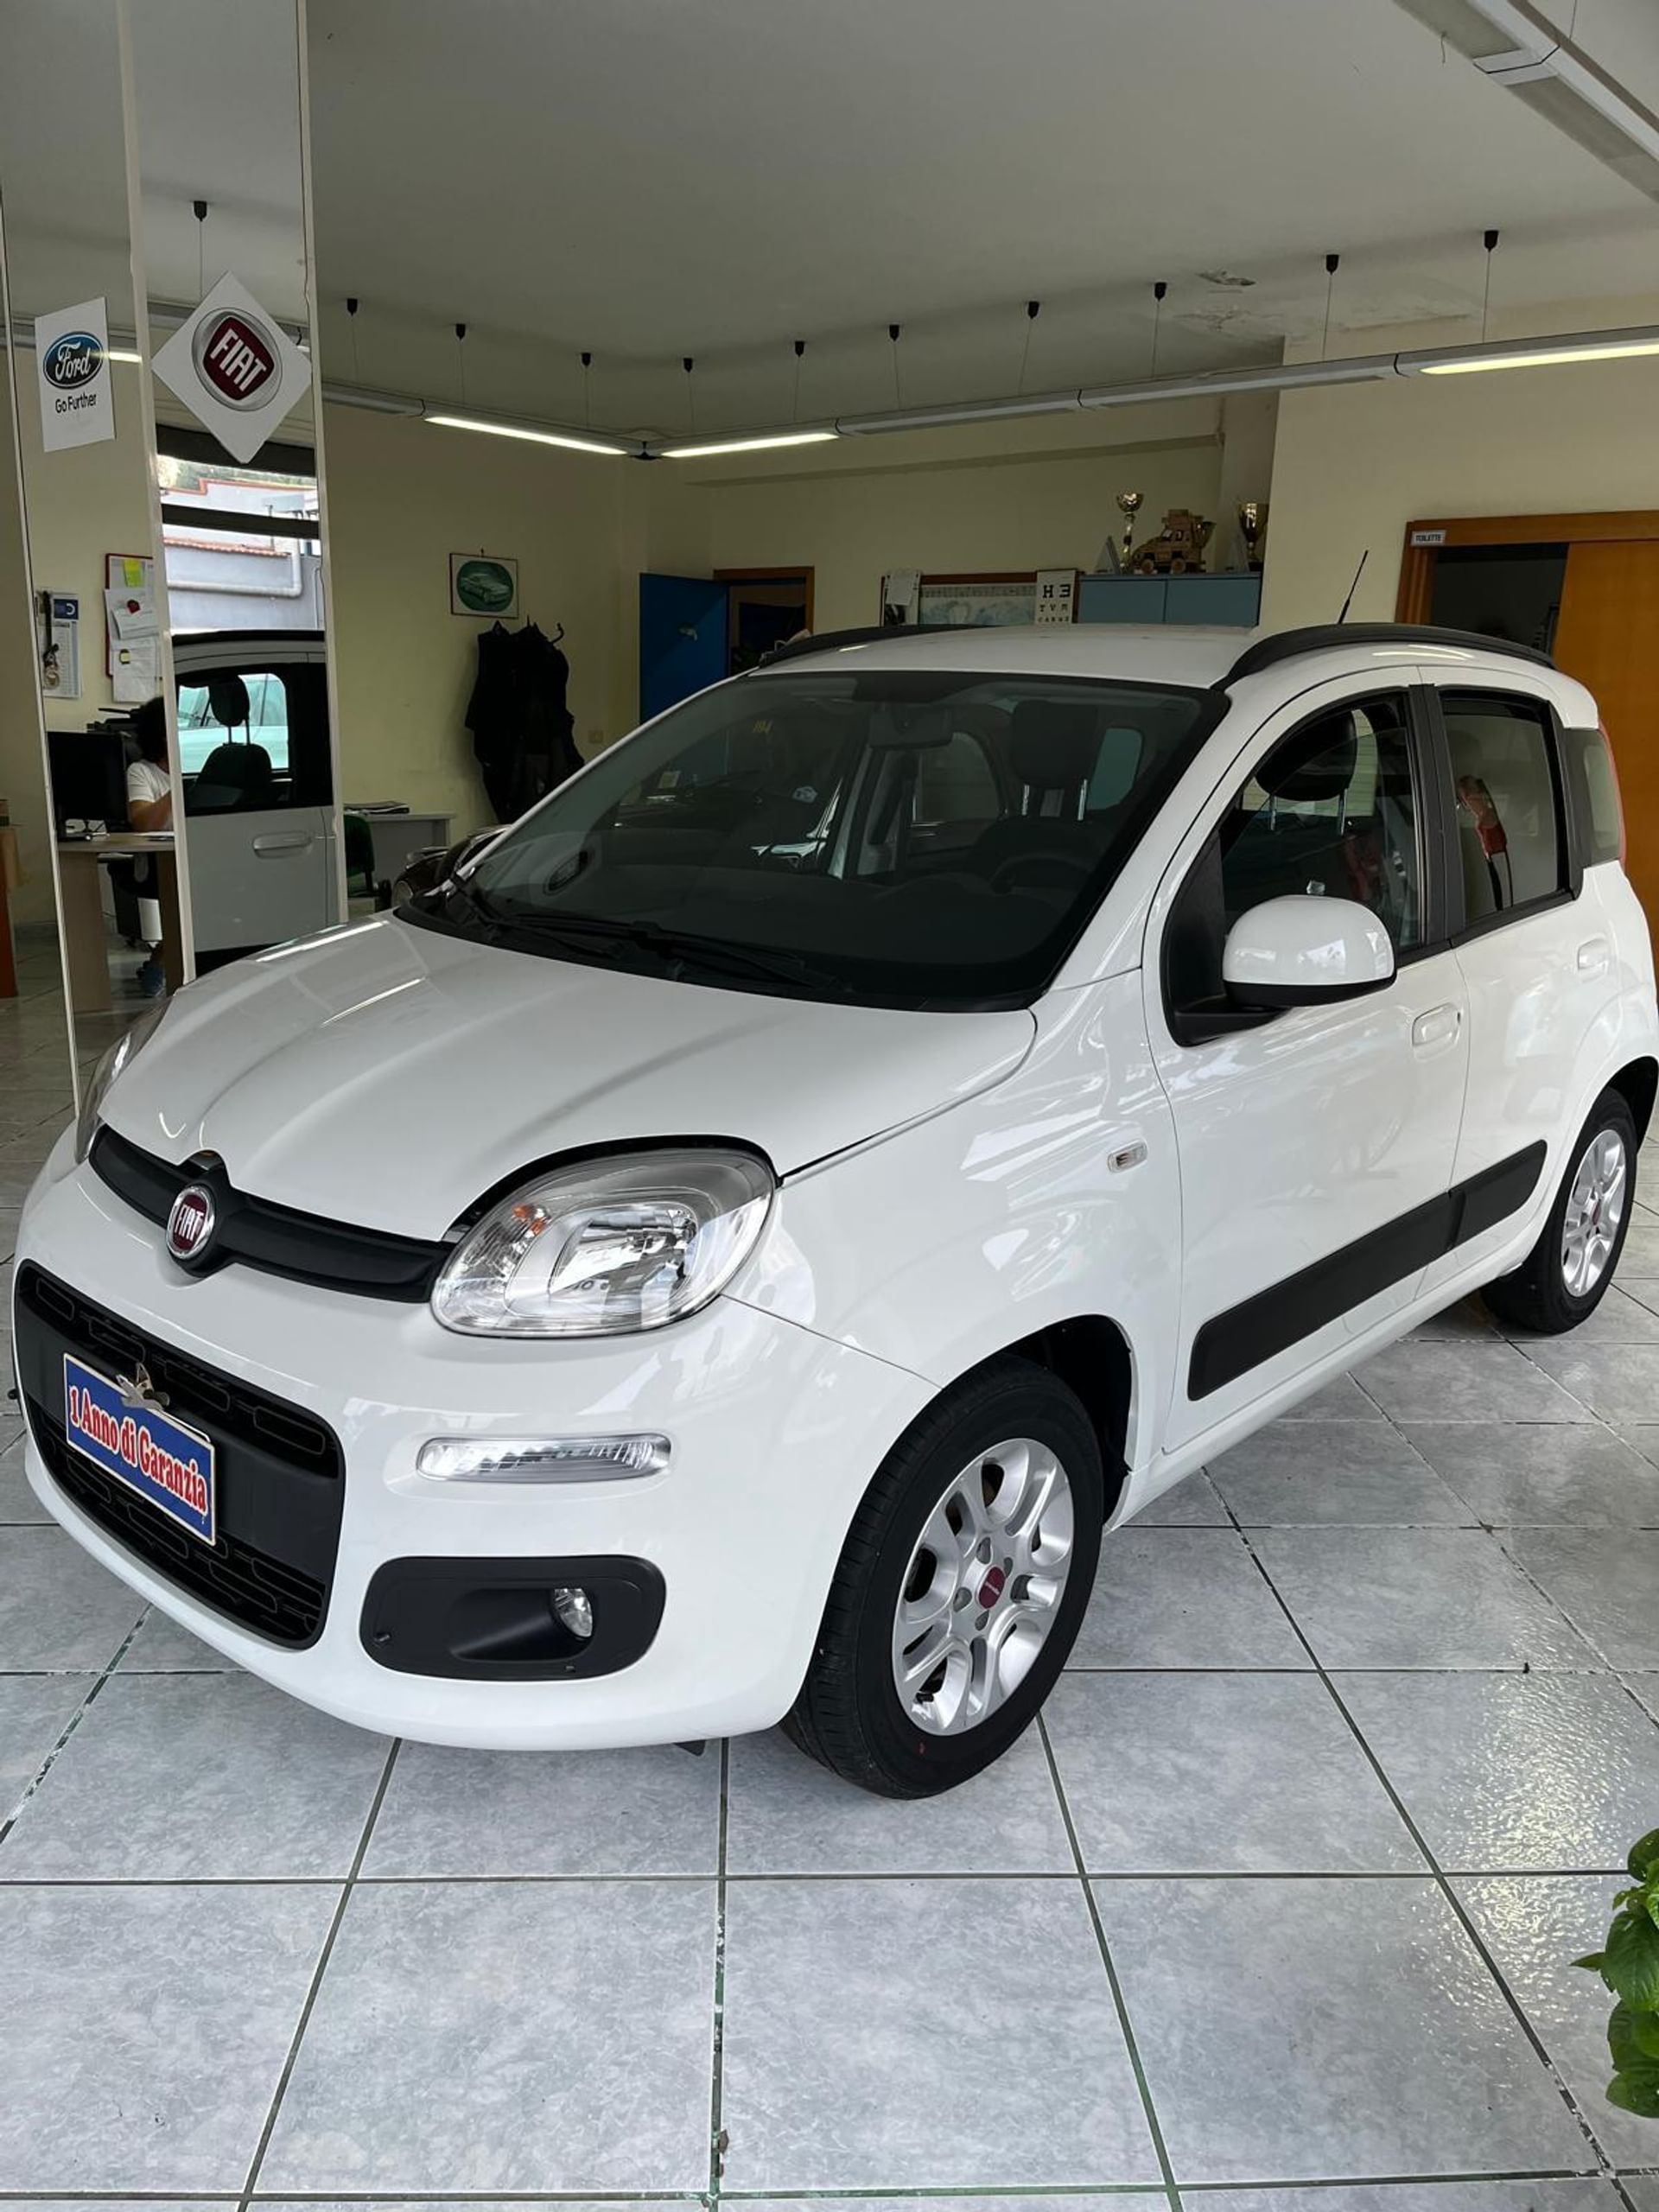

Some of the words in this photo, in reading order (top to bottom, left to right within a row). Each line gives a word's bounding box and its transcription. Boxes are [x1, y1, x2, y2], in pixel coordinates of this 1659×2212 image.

[55, 341, 92, 381] Ford
[210, 328, 267, 391] FIAT
[55, 398, 67, 413] Go
[68, 391, 97, 410] Further
[175, 1203, 205, 1242] FIAT
[69, 1385, 79, 1428] 1
[81, 1388, 119, 1455] Anno
[121, 1416, 138, 1468] di
[138, 1426, 208, 1516] Garanzia
